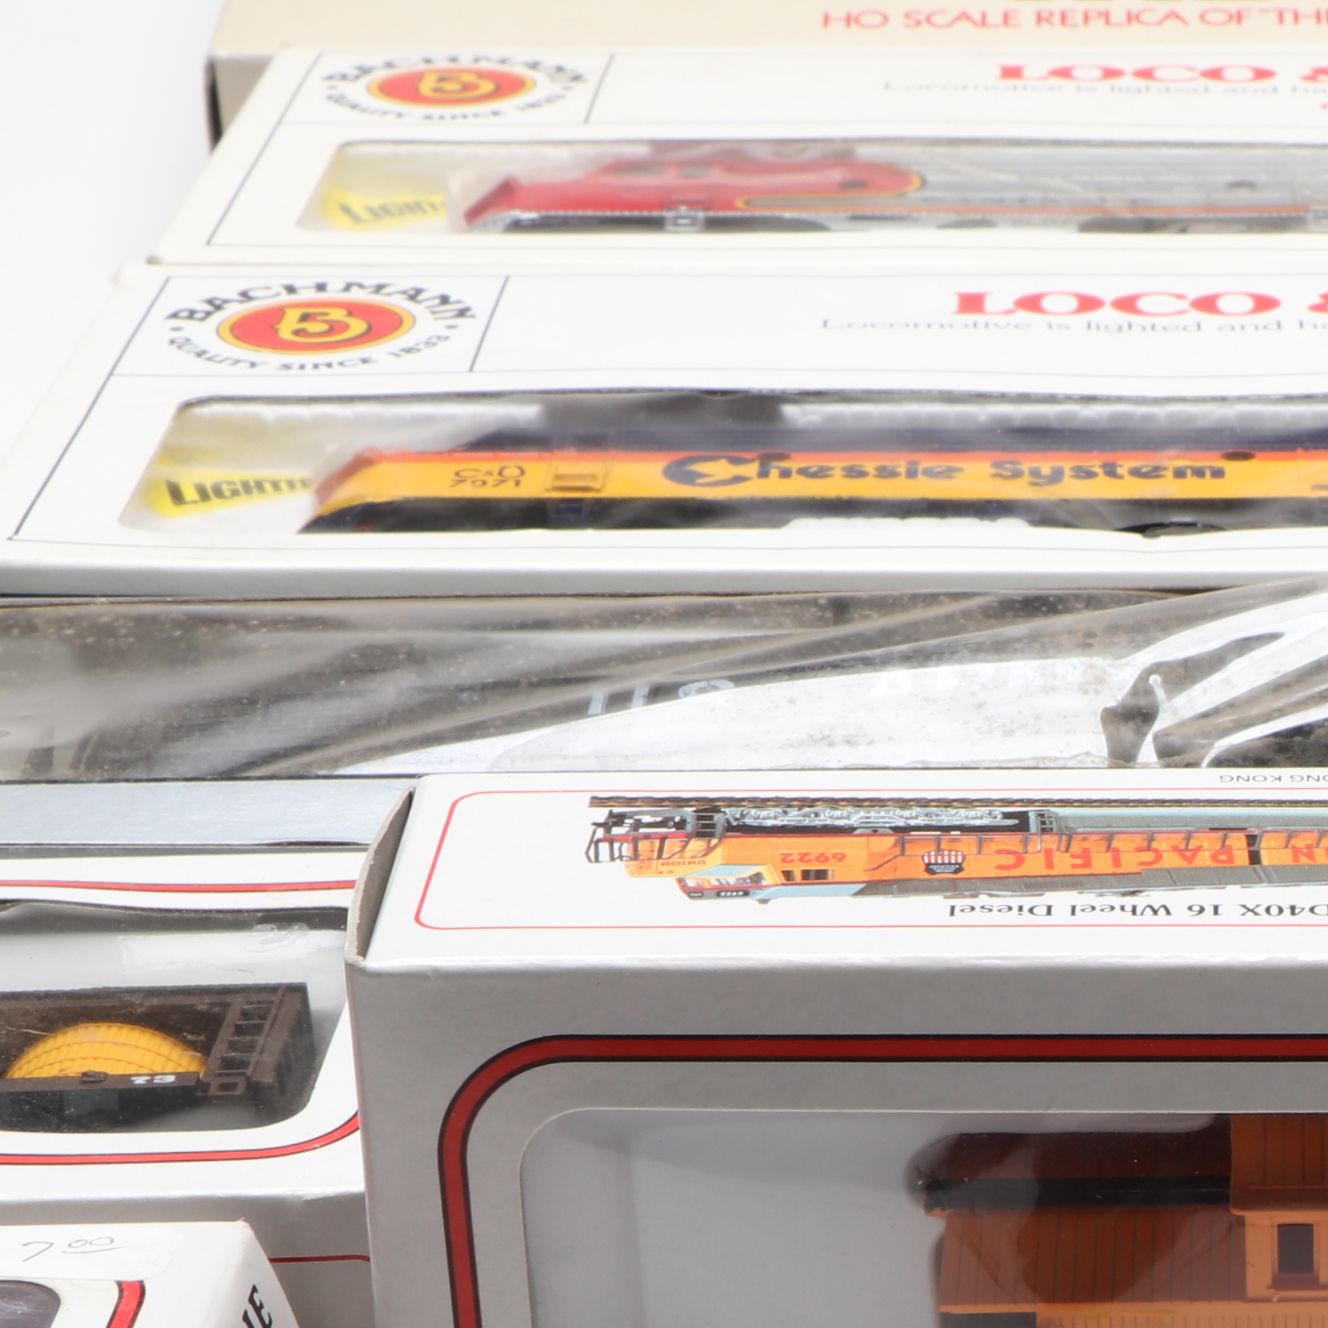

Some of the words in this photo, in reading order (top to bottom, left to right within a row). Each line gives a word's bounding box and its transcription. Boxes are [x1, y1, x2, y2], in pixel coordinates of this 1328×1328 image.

[822, 10, 889, 29] HO
[903, 9, 1022, 28] SCALE
[1035, 8, 1189, 27] REPLICA
[1200, 9, 1246, 26] OF
[998, 64, 1278, 83] LOCO
[163, 281, 477, 322] BACHMANN
[953, 290, 1282, 317] LOCO
[821, 318, 1034, 331] Locomotive
[1046, 320, 1072, 332] is
[1085, 320, 1203, 335] lighted
[1216, 320, 1283, 332] and
[167, 334, 271, 371] QUALITY
[276, 355, 380, 371] SINCE
[661, 454, 964, 488] Chessie
[989, 459, 1227, 487] System
[1218, 773, 1284, 783] KONG
[778, 851, 847, 864] 6922
[993, 845, 1235, 871] PACIFIC
[948, 902, 1055, 918] Diesel
[1060, 903, 1173, 918] Wheel
[1187, 903, 1225, 917] 16
